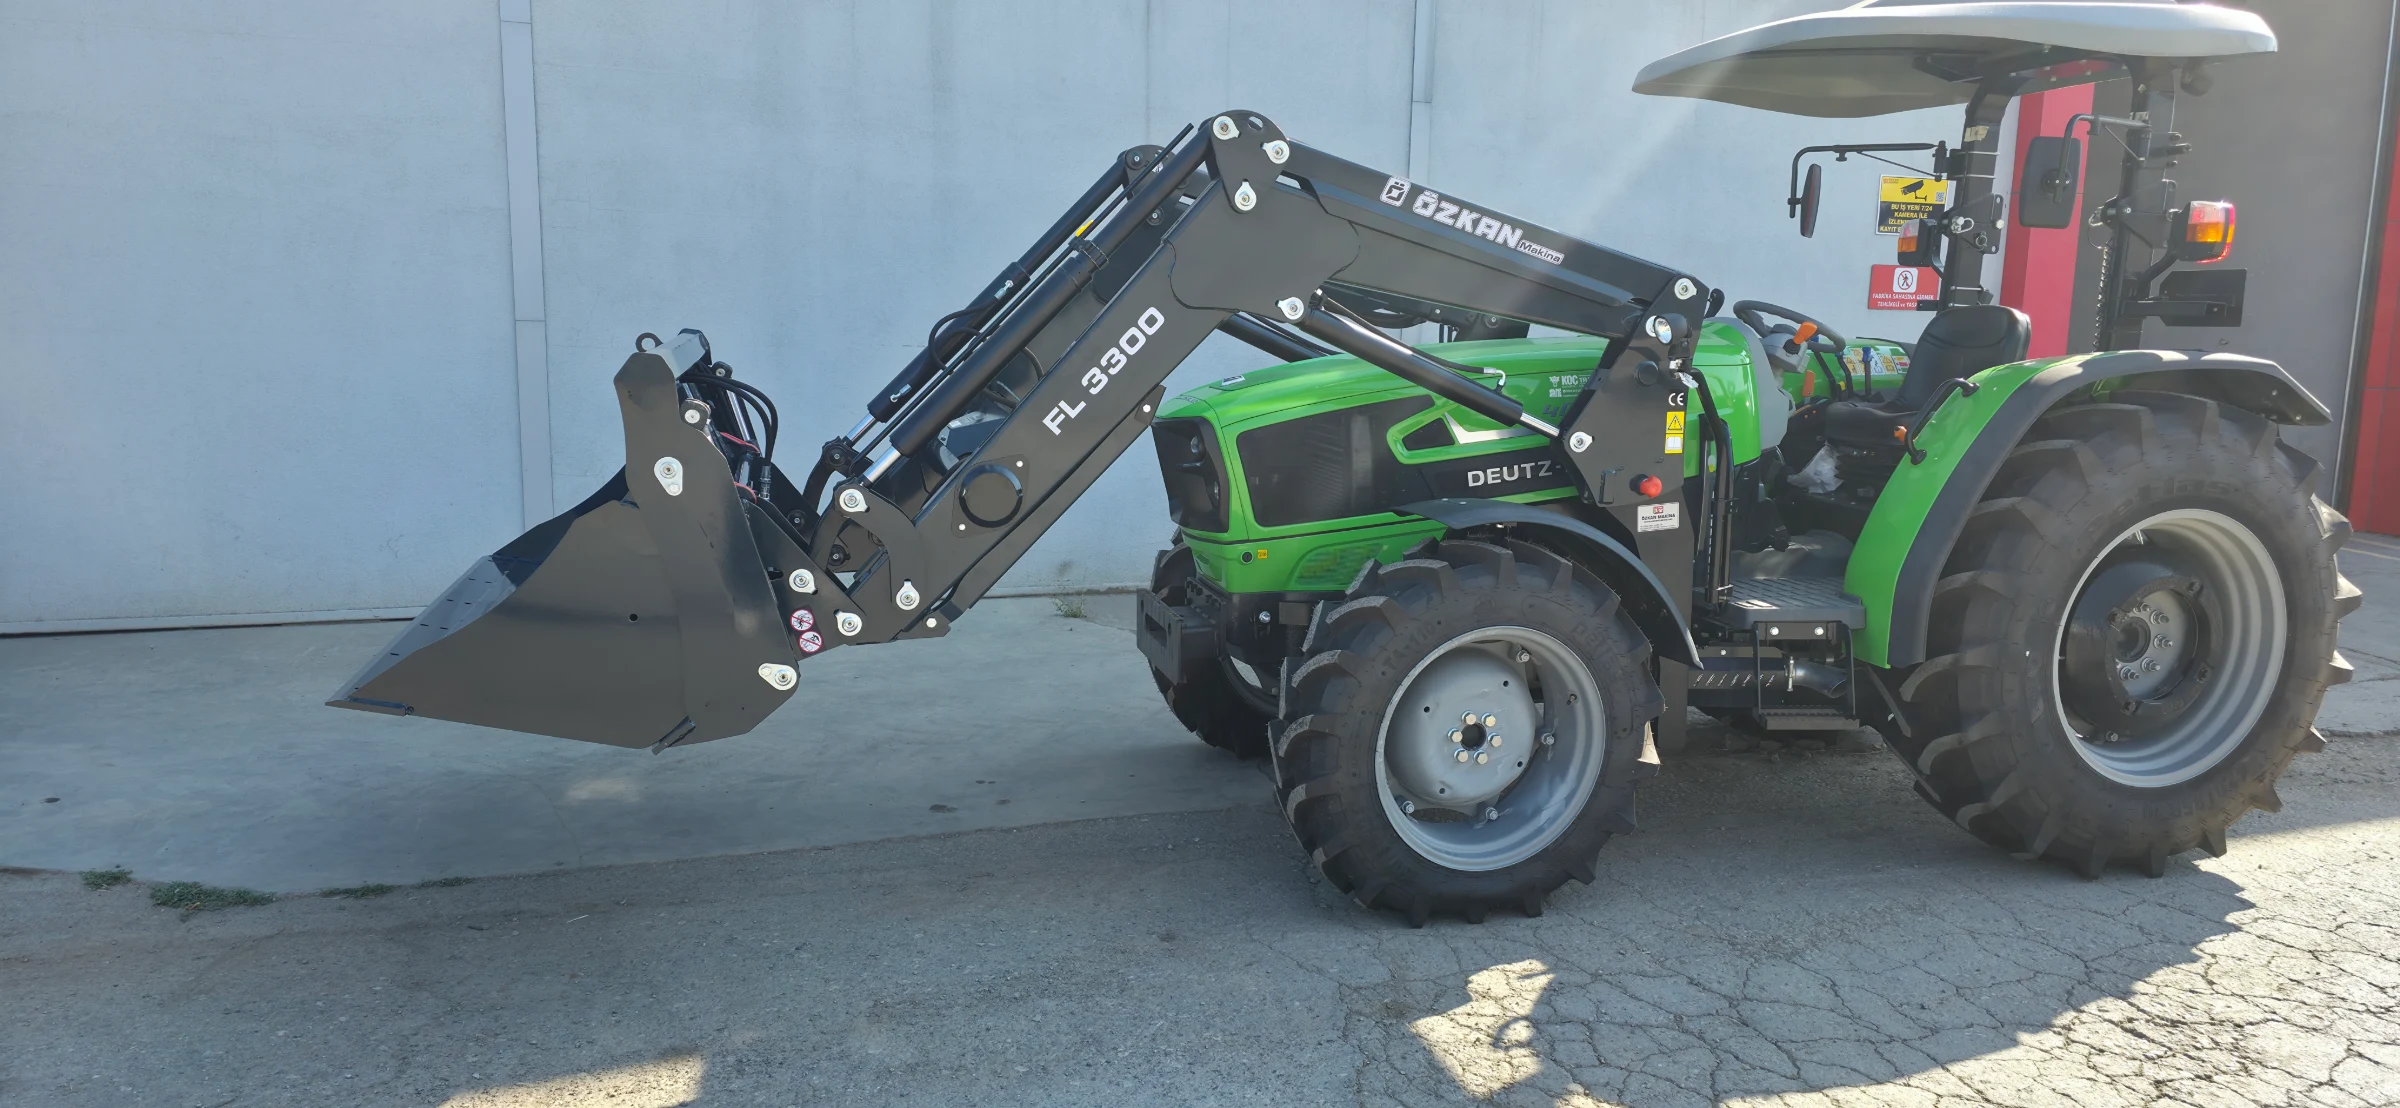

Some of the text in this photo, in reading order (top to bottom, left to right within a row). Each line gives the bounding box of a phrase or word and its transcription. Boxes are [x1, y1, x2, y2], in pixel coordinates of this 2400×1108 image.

[1412, 189, 1562, 264] ÖZKAN Makina
[1042, 306, 1165, 436] FL 3300
[1668, 392, 1685, 406] CE
